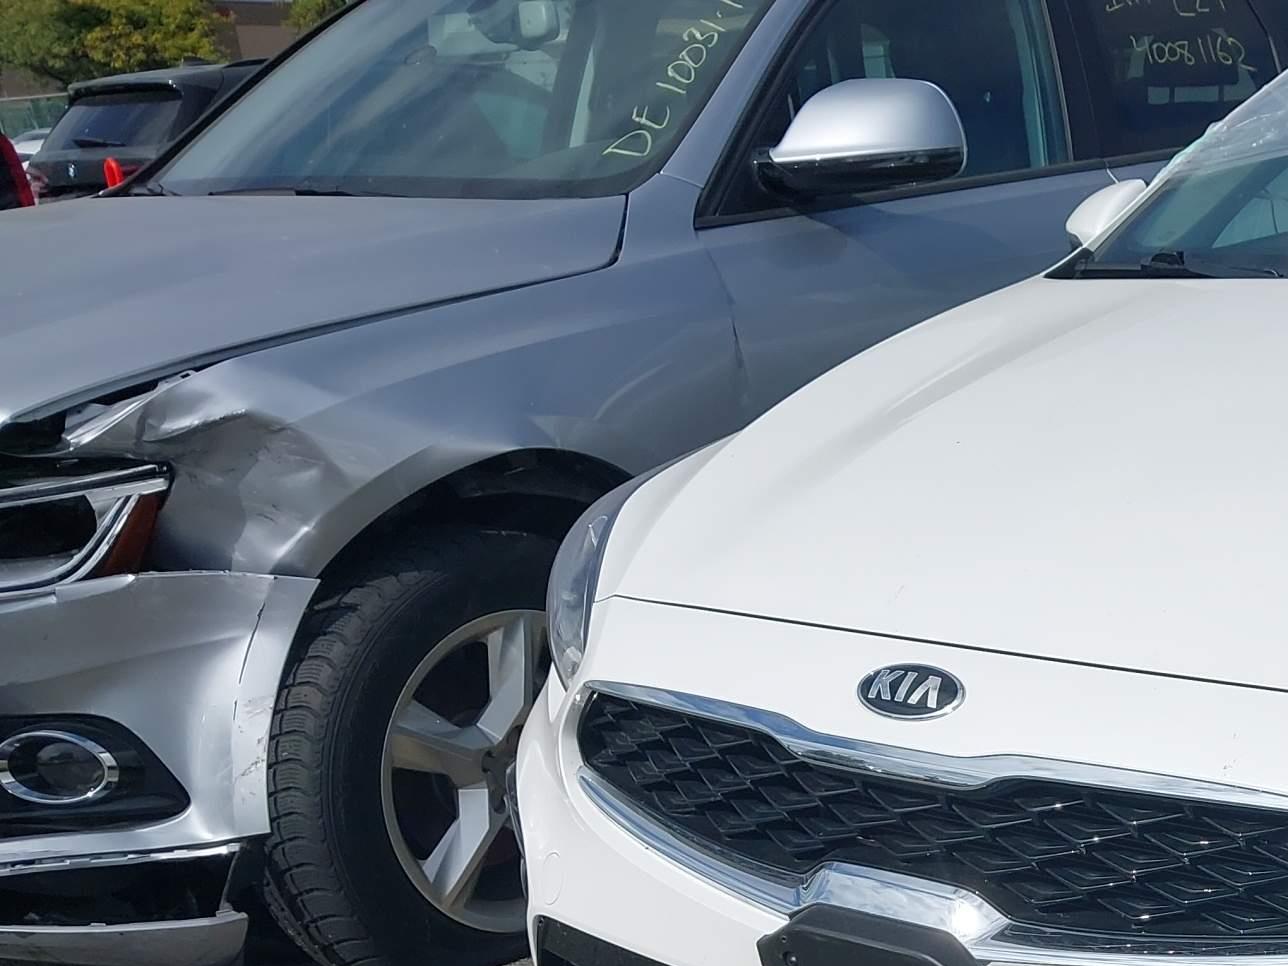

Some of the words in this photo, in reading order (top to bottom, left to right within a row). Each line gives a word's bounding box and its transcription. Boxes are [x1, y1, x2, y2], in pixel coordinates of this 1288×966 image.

[1129, 35, 1257, 71] 40081162
[603, 104, 670, 156] DE
[867, 669, 942, 709] KIA
